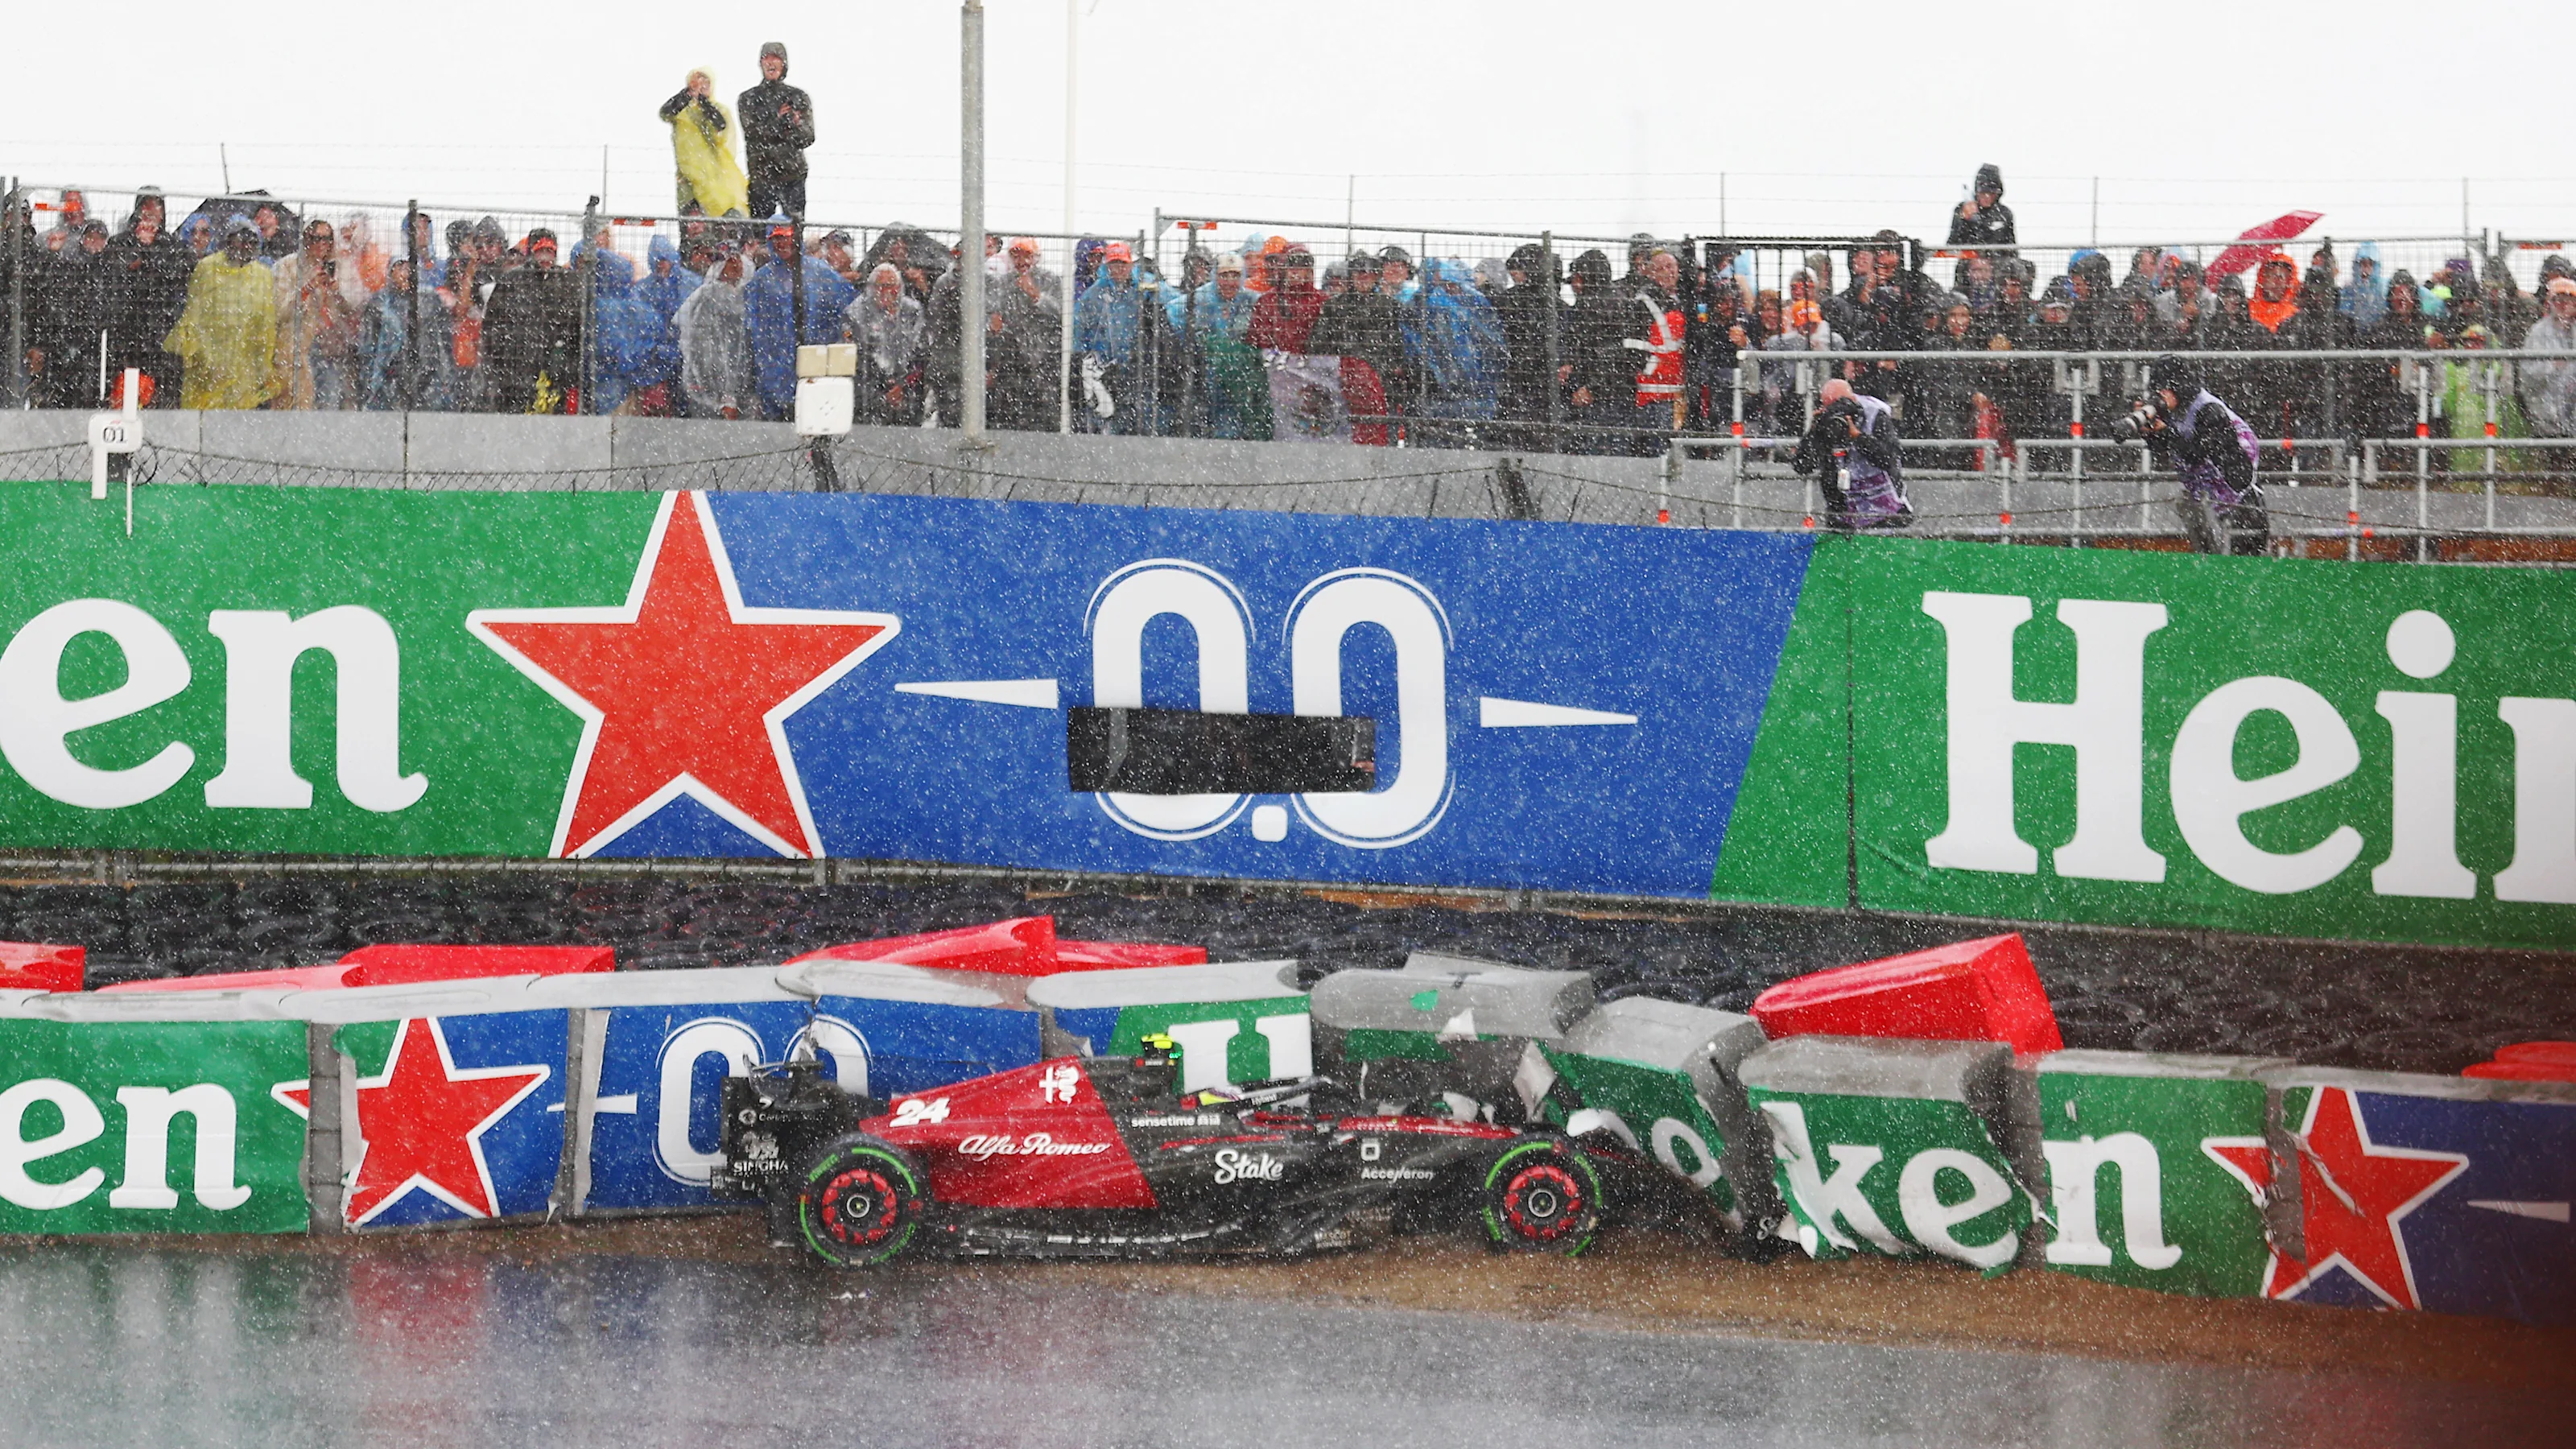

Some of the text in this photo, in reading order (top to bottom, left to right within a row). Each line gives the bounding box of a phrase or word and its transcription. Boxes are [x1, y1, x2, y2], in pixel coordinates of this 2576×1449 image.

[0, 597, 429, 813] en
[890, 1097, 950, 1127] 24
[1131, 1113, 1196, 1127] sensetime
[0, 1077, 252, 1211] en
[958, 1133, 1110, 1162] Alfa Romeo
[1214, 1148, 1284, 1185] Stake
